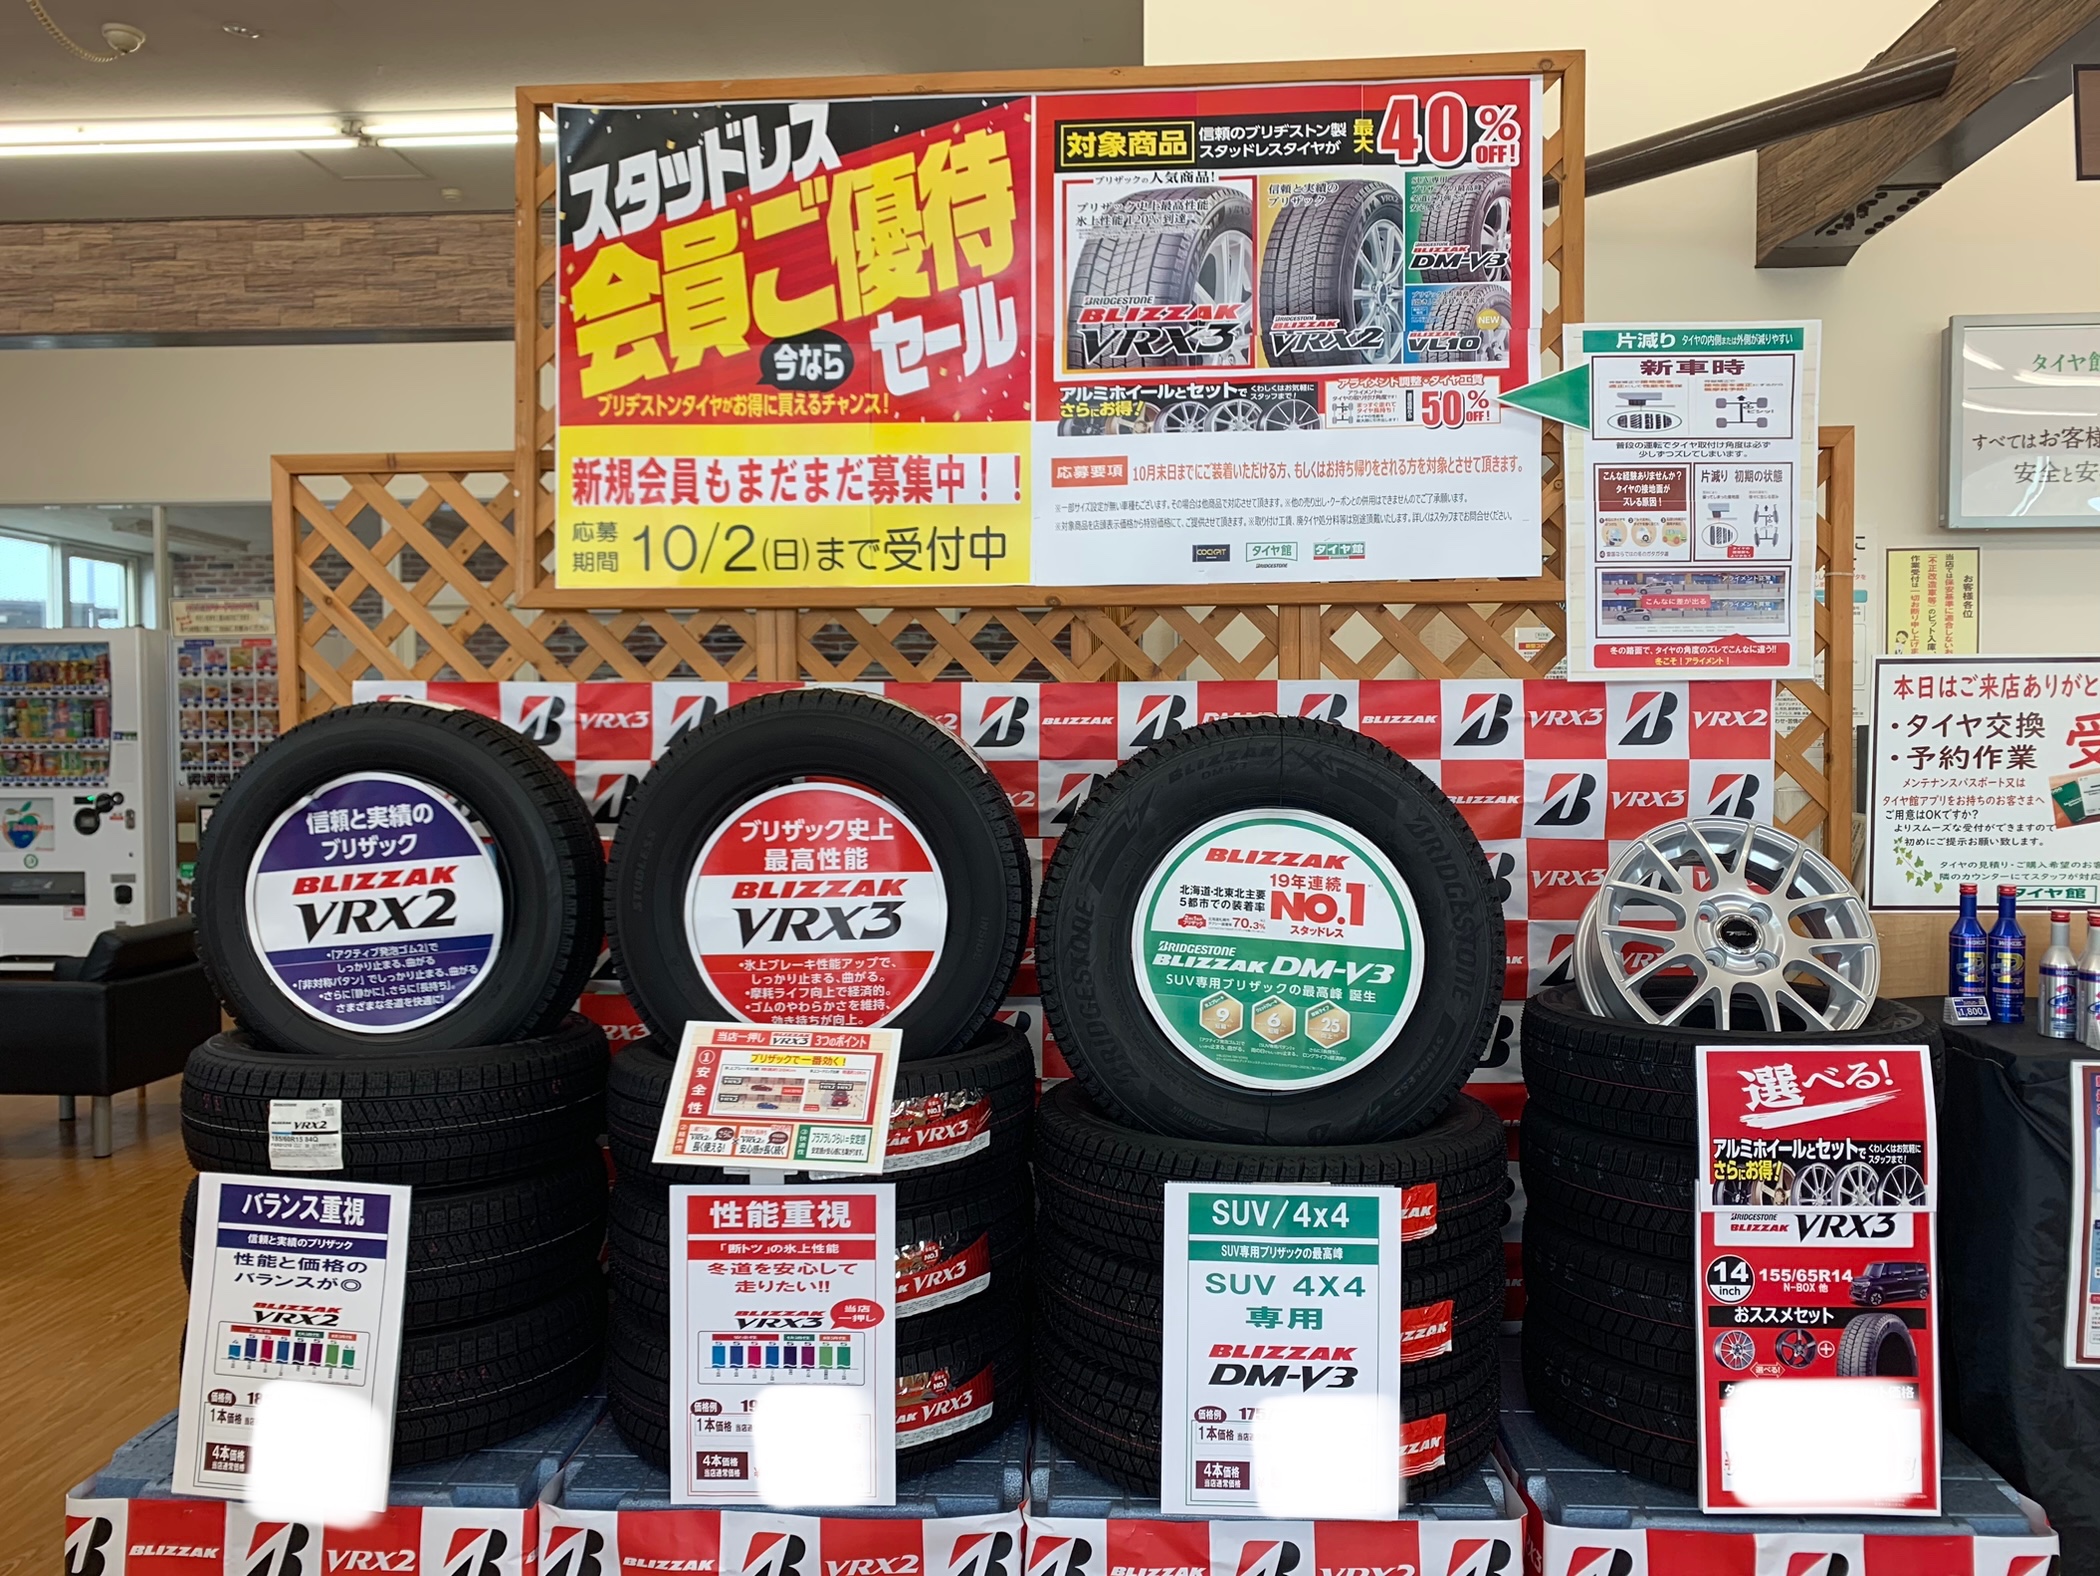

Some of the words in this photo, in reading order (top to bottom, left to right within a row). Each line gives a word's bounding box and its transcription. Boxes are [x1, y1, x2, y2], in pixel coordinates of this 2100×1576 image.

[1199, 121, 1346, 142] 信頼のブリヂストン製
[1353, 118, 1374, 155] 最大
[1066, 132, 1188, 159] 対象商品
[1199, 140, 1341, 159] スタッドレスタイヤが
[569, 103, 841, 251] スタッドレス
[1269, 182, 1339, 194] 信頼と実績の
[1268, 196, 1326, 207] ブリザック
[1413, 246, 1468, 254] BLIZZAK
[572, 129, 1015, 398] 会員ご優待
[1409, 252, 1508, 272] DM-V3
[1083, 295, 1154, 306] BRIDGESTONE
[1079, 304, 1241, 324] BLIZZAK
[1479, 315, 1499, 324] NEW
[1272, 321, 1338, 330] BLIZZAK
[870, 281, 1016, 395] セール
[1080, 323, 1237, 365] VRX3
[1269, 327, 1384, 357] VRX2
[1408, 337, 1481, 352] VL10
[1616, 332, 1676, 349] 片減り
[773, 344, 844, 380] 今なら
[1640, 360, 1745, 375] 新車時
[1060, 383, 1247, 402] アルミホイールとセットで
[1250, 384, 1314, 392] くわしくはお気軽に
[1639, 450, 1748, 458] 少しずつズレてしまいます。
[1057, 464, 1123, 479] 応募要項
[1701, 470, 1728, 482] 片減り
[1735, 470, 1783, 482] 初期の状態
[1616, 484, 1670, 494] タイヤの接地面が
[572, 522, 618, 543] 応募
[1252, 545, 1292, 557] タイヤ館
[1315, 543, 1365, 555] タイヤ館
[572, 551, 618, 573] 期間
[1963, 574, 1974, 618] お客様各位
[1893, 673, 2098, 700] 本日はご来店ありがと
[579, 711, 650, 731] VRX3
[1041, 716, 1113, 726] BLIZZAK
[1362, 715, 1438, 725] BLIZZAK
[1528, 708, 1605, 728] VRX3
[1692, 709, 1768, 728] VRX2
[1903, 777, 2026, 788] メンテナンスパスポート又は
[1611, 790, 1686, 810] VRX3
[1882, 795, 2045, 806] タイヤ館アプリをお持ちのお客さまへ
[306, 803, 434, 835] 信頼と実績の
[739, 817, 894, 842] ブリザック史上
[321, 833, 418, 861] ブリザック
[1904, 837, 2044, 847] 初めにご提示お願い致します。
[764, 848, 868, 872] 最高性能
[1205, 848, 1350, 870] BLIZZAK
[292, 865, 460, 895] BLIZZAK
[1270, 873, 1342, 893] 19年連続
[1530, 868, 1606, 889] VRX3
[731, 879, 909, 899] BLIZZAK
[1179, 897, 1266, 912] 5都市での装着率
[1270, 883, 1365, 926] NO.1
[294, 888, 457, 944] VRX2
[732, 901, 907, 949] VRX3
[1290, 925, 1344, 938] スタッドレス
[1158, 941, 1236, 957] BRIDGESTONE
[752, 971, 885, 984] しっかり止まる、曲がる。
[1152, 954, 1268, 974] BLIZZAK
[1270, 956, 1395, 986] DM-V3
[1166, 973, 1343, 1000] SUV専用ブリザックの最高峰
[1349, 989, 1376, 1003] 誕生
[1321, 1017, 1340, 1032] 25
[718, 1032, 765, 1043] 当店一押し
[772, 1037, 808, 1046] VRX3
[815, 1034, 867, 1049] 3つのポイント
[687, 1067, 710, 1114] 安全性
[294, 1121, 327, 1129] VRX2
[916, 1119, 970, 1147] VRX3
[1713, 1138, 1867, 1160] アルミホイールとセットで
[1868, 1144, 1921, 1153] くわしくはお気軽に
[1713, 1160, 1783, 1181] さらにお得!
[242, 1192, 365, 1226] バランス重視
[709, 1200, 852, 1229] 性能重視
[1212, 1199, 1350, 1229] SUV/4x4
[1730, 1213, 1777, 1221] BRIDGESTONE
[1730, 1224, 1789, 1232] BLIZZAK
[1794, 1213, 1898, 1242] VRX3
[247, 1233, 353, 1250] 信頼と実績のブリザック
[719, 1243, 840, 1255] 「断トツ」の氷上性能
[1221, 1244, 1344, 1261] SUV専用ブリザックの最高峰
[234, 1251, 367, 1274] 性能と価格の
[707, 1262, 858, 1276] 冬道を安心して
[914, 1260, 967, 1293] VRX3
[1713, 1262, 1749, 1282] 14
[1759, 1269, 1853, 1283] 155/65R14
[1205, 1272, 1276, 1296] SUV
[1293, 1276, 1366, 1297] 4X4
[1719, 1286, 1741, 1296] inch
[1783, 1282, 1816, 1292] N-BOX
[1818, 1283, 1829, 1293] 他
[253, 1302, 342, 1313] BLIZZAK
[844, 1305, 871, 1313] 当店
[1734, 1307, 1835, 1324] おススメセット
[253, 1310, 340, 1326] VRX2
[737, 1317, 823, 1329] VRX3
[838, 1314, 876, 1323] 一押し
[1246, 1306, 1323, 1330] 専用
[1208, 1344, 1358, 1361] BLIZZAK
[1208, 1363, 1359, 1392] DM-V3
[211, 1392, 232, 1403] 価格例
[921, 1389, 974, 1422] VRX3
[210, 1408, 242, 1424] 1本価格
[694, 1402, 718, 1413] 価格例
[1198, 1409, 1222, 1420] 価格例
[697, 1417, 732, 1432] 1本価格
[1199, 1425, 1234, 1441] 1本価格
[212, 1445, 245, 1461] 4本価格
[702, 1455, 738, 1467] 4本価格
[704, 1469, 740, 1477] 当店通常価格
[1203, 1462, 1240, 1478] 4本価格
[1204, 1479, 1241, 1488] 当店通常価格
[128, 1545, 220, 1559] BLIZZAK
[326, 1549, 416, 1573] VRX2
[622, 1557, 715, 1572] BLIZZAK
[824, 1555, 920, 1576] VRX2
